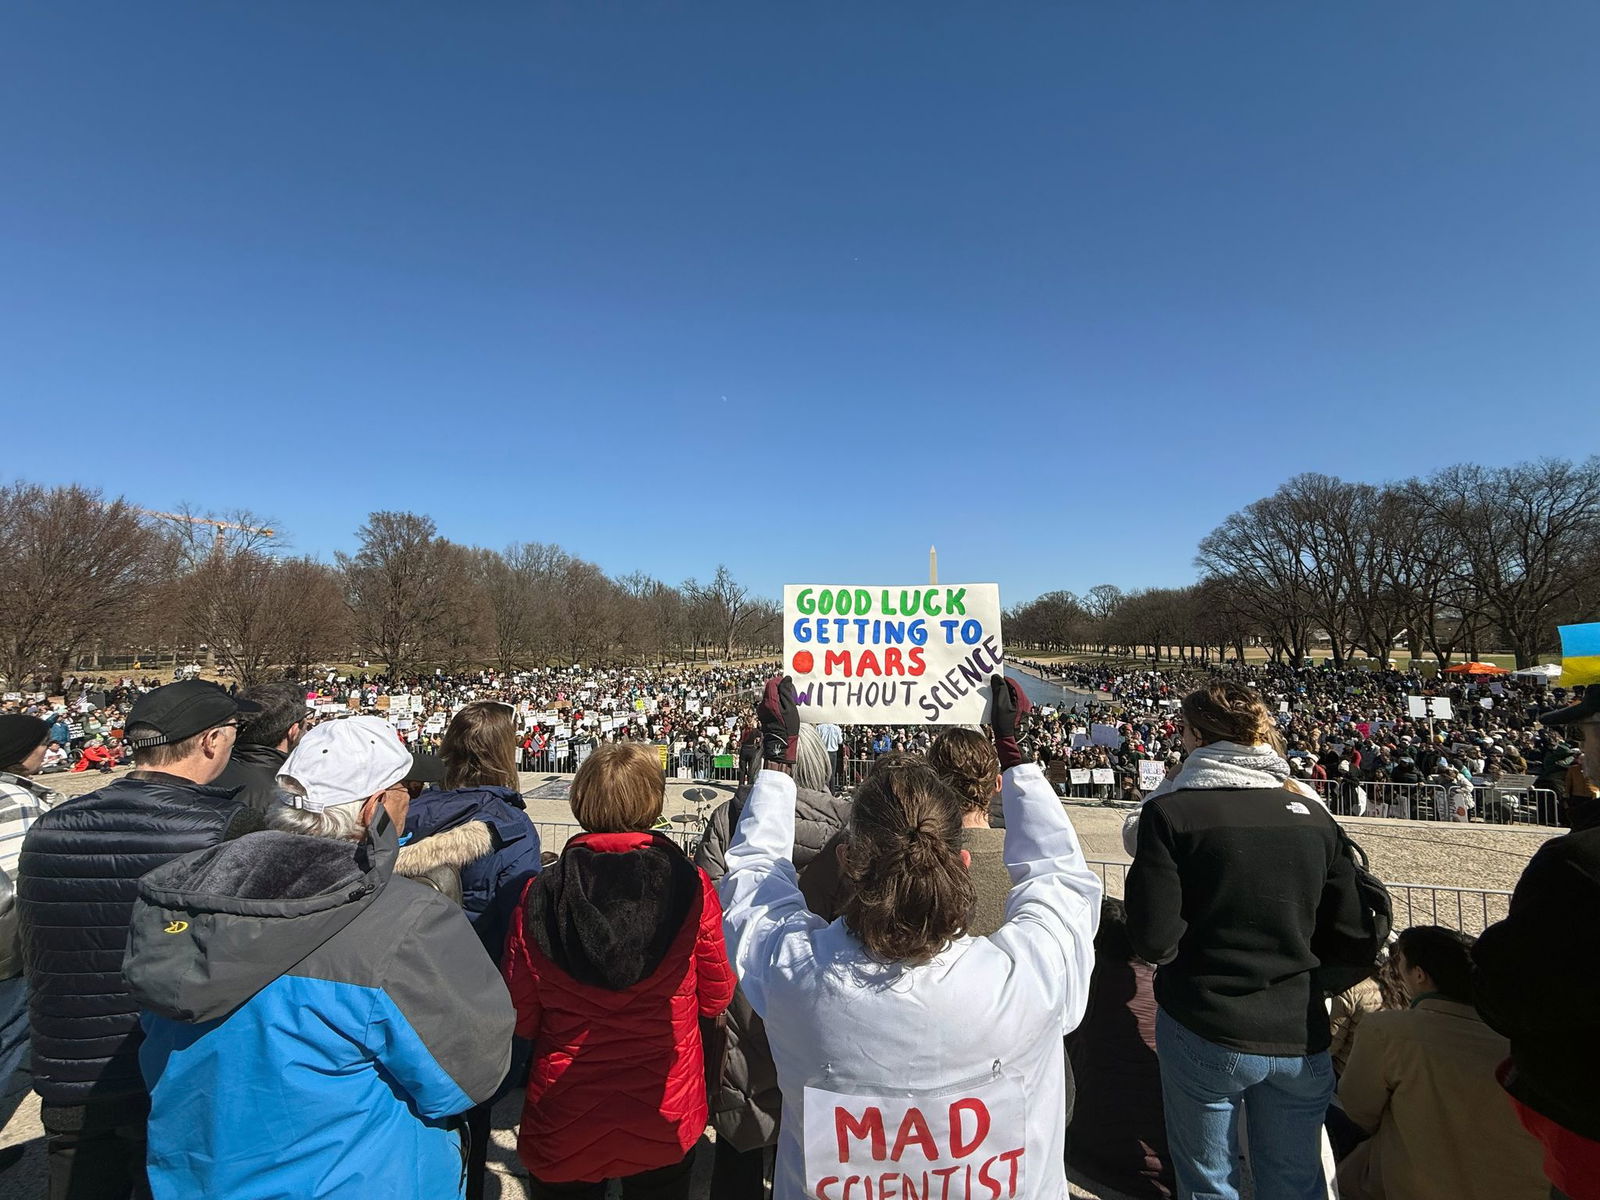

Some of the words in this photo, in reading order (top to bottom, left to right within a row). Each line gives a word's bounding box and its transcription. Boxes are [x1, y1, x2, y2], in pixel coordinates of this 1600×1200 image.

[796, 588, 872, 616] GOOD
[881, 588, 967, 616] LUCK
[793, 617, 928, 645] GETTING
[940, 619, 983, 645] TO
[792, 681, 918, 707] WITHOUT
[918, 635, 1005, 721] SCIENCE
[824, 646, 927, 678] MARS
[834, 1097, 991, 1164] MAD
